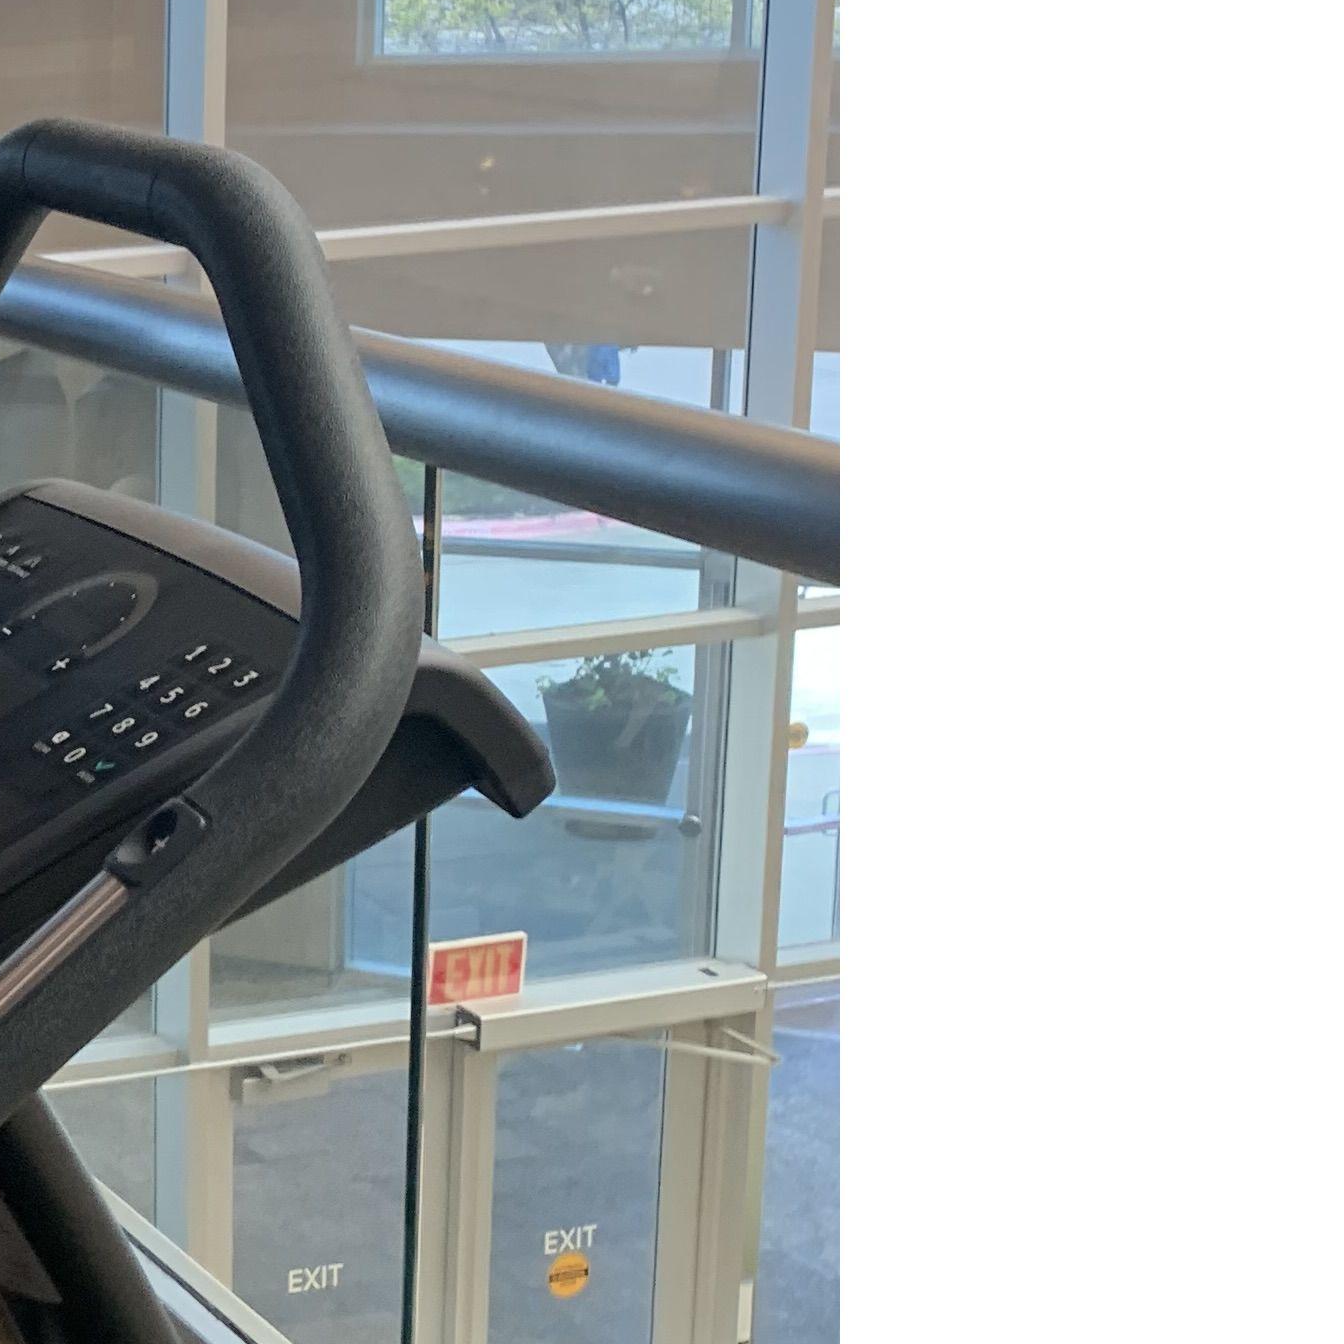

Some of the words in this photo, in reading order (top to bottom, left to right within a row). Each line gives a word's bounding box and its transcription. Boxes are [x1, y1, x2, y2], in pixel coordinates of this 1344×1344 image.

[184, 644, 207, 661] 1
[208, 657, 232, 674] 2
[233, 670, 259, 687] 3
[139, 674, 161, 690] 4
[160, 686, 184, 703] 5
[184, 701, 209, 718] 6
[89, 702, 113, 719] 7
[112, 717, 136, 734] 8
[134, 731, 159, 748] 9
[63, 747, 86, 763] 0
[443, 943, 514, 1000] EXIT
[544, 1224, 597, 1255] EXIT
[288, 1263, 344, 1294] EXIT
